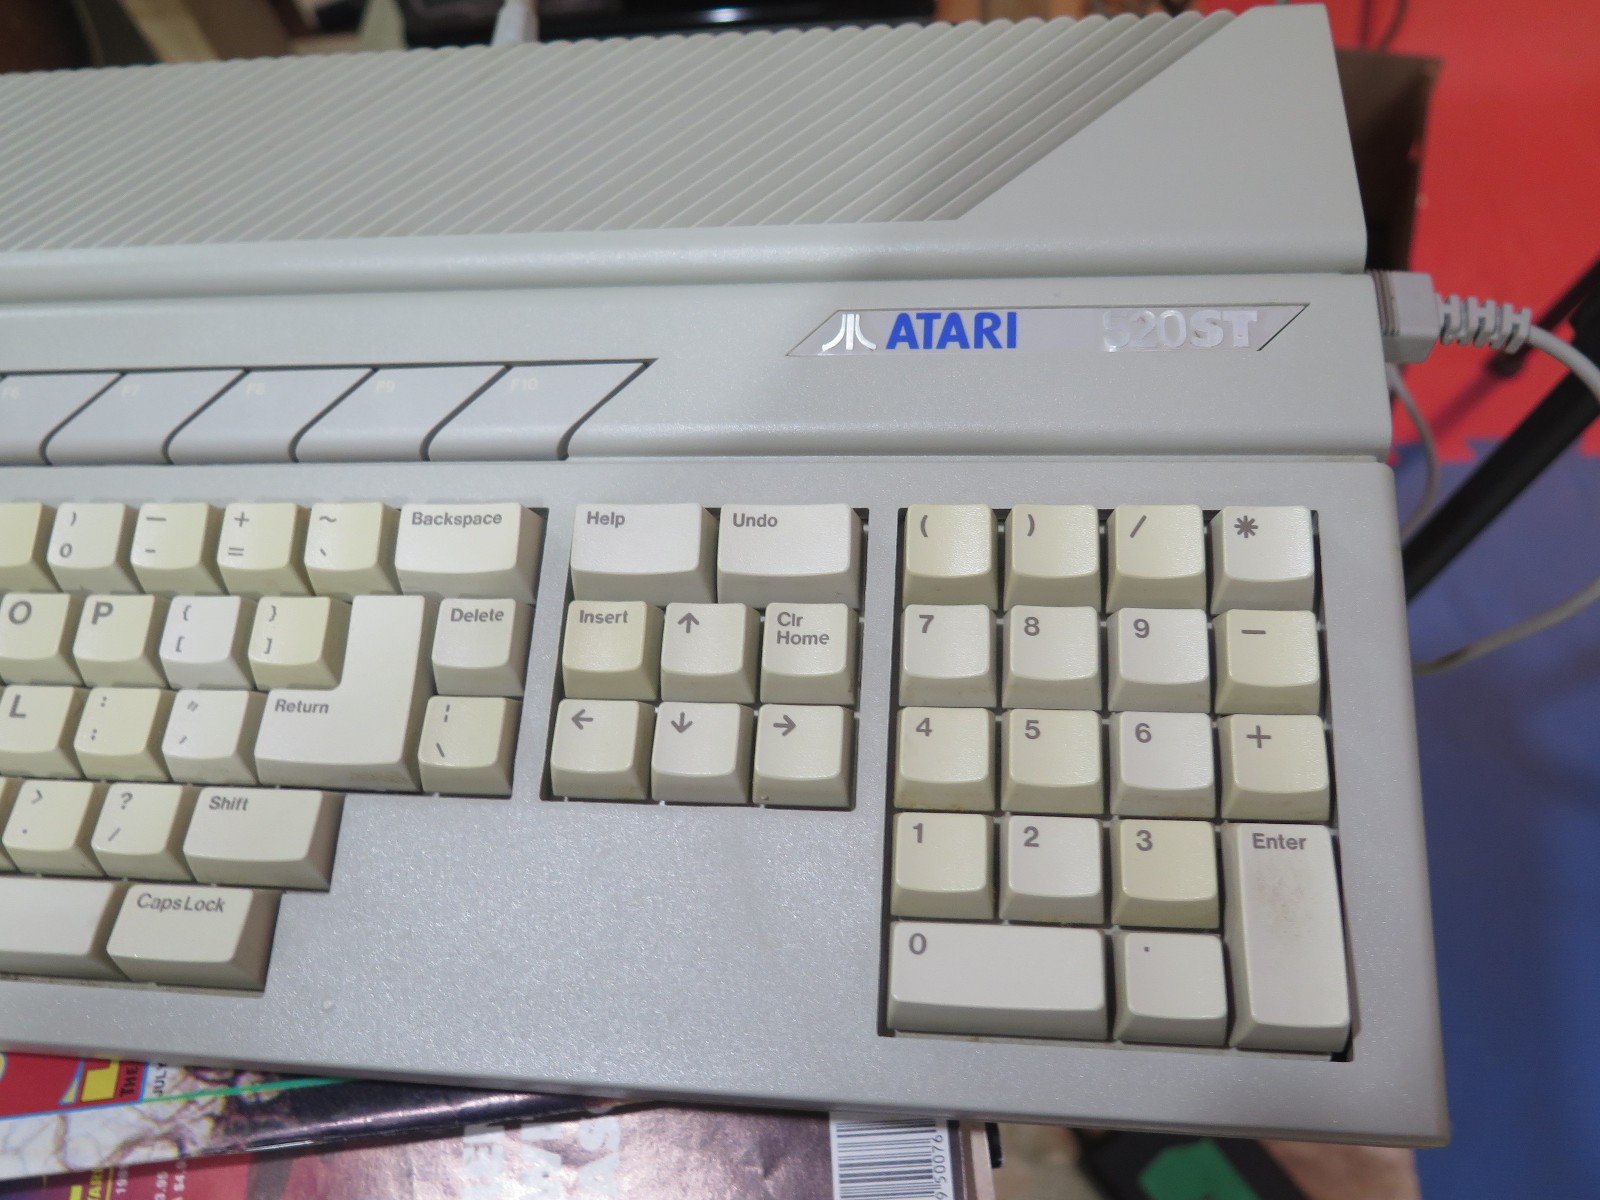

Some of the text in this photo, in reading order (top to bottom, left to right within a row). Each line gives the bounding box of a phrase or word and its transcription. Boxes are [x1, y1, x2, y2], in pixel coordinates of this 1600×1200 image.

[885, 312, 1018, 350] ATARI
[376, 379, 396, 393] F9
[510, 378, 539, 391] F10
[412, 512, 502, 528] Backspace
[587, 511, 625, 528] Help
[733, 513, 777, 527] Undo
[8, 600, 33, 625] O
[91, 601, 114, 626] P
[451, 608, 504, 622] Delete
[580, 610, 628, 624] Insert
[777, 612, 803, 626] Clr
[918, 614, 935, 634] 7
[1023, 616, 1041, 637] 8
[1132, 618, 1150, 639] 9
[777, 631, 829, 645] Home
[8, 693, 28, 719] L
[275, 699, 329, 713] Return
[915, 717, 933, 737] 4
[1024, 719, 1041, 740] 5
[1134, 722, 1152, 744] 6
[208, 795, 249, 811] Shift
[912, 822, 924, 844] 1
[1023, 825, 1040, 848] 2
[1135, 829, 1153, 852] 3
[1252, 833, 1306, 850] Enter
[908, 932, 927, 956] 0
[931, 1134, 947, 1183] 50076
